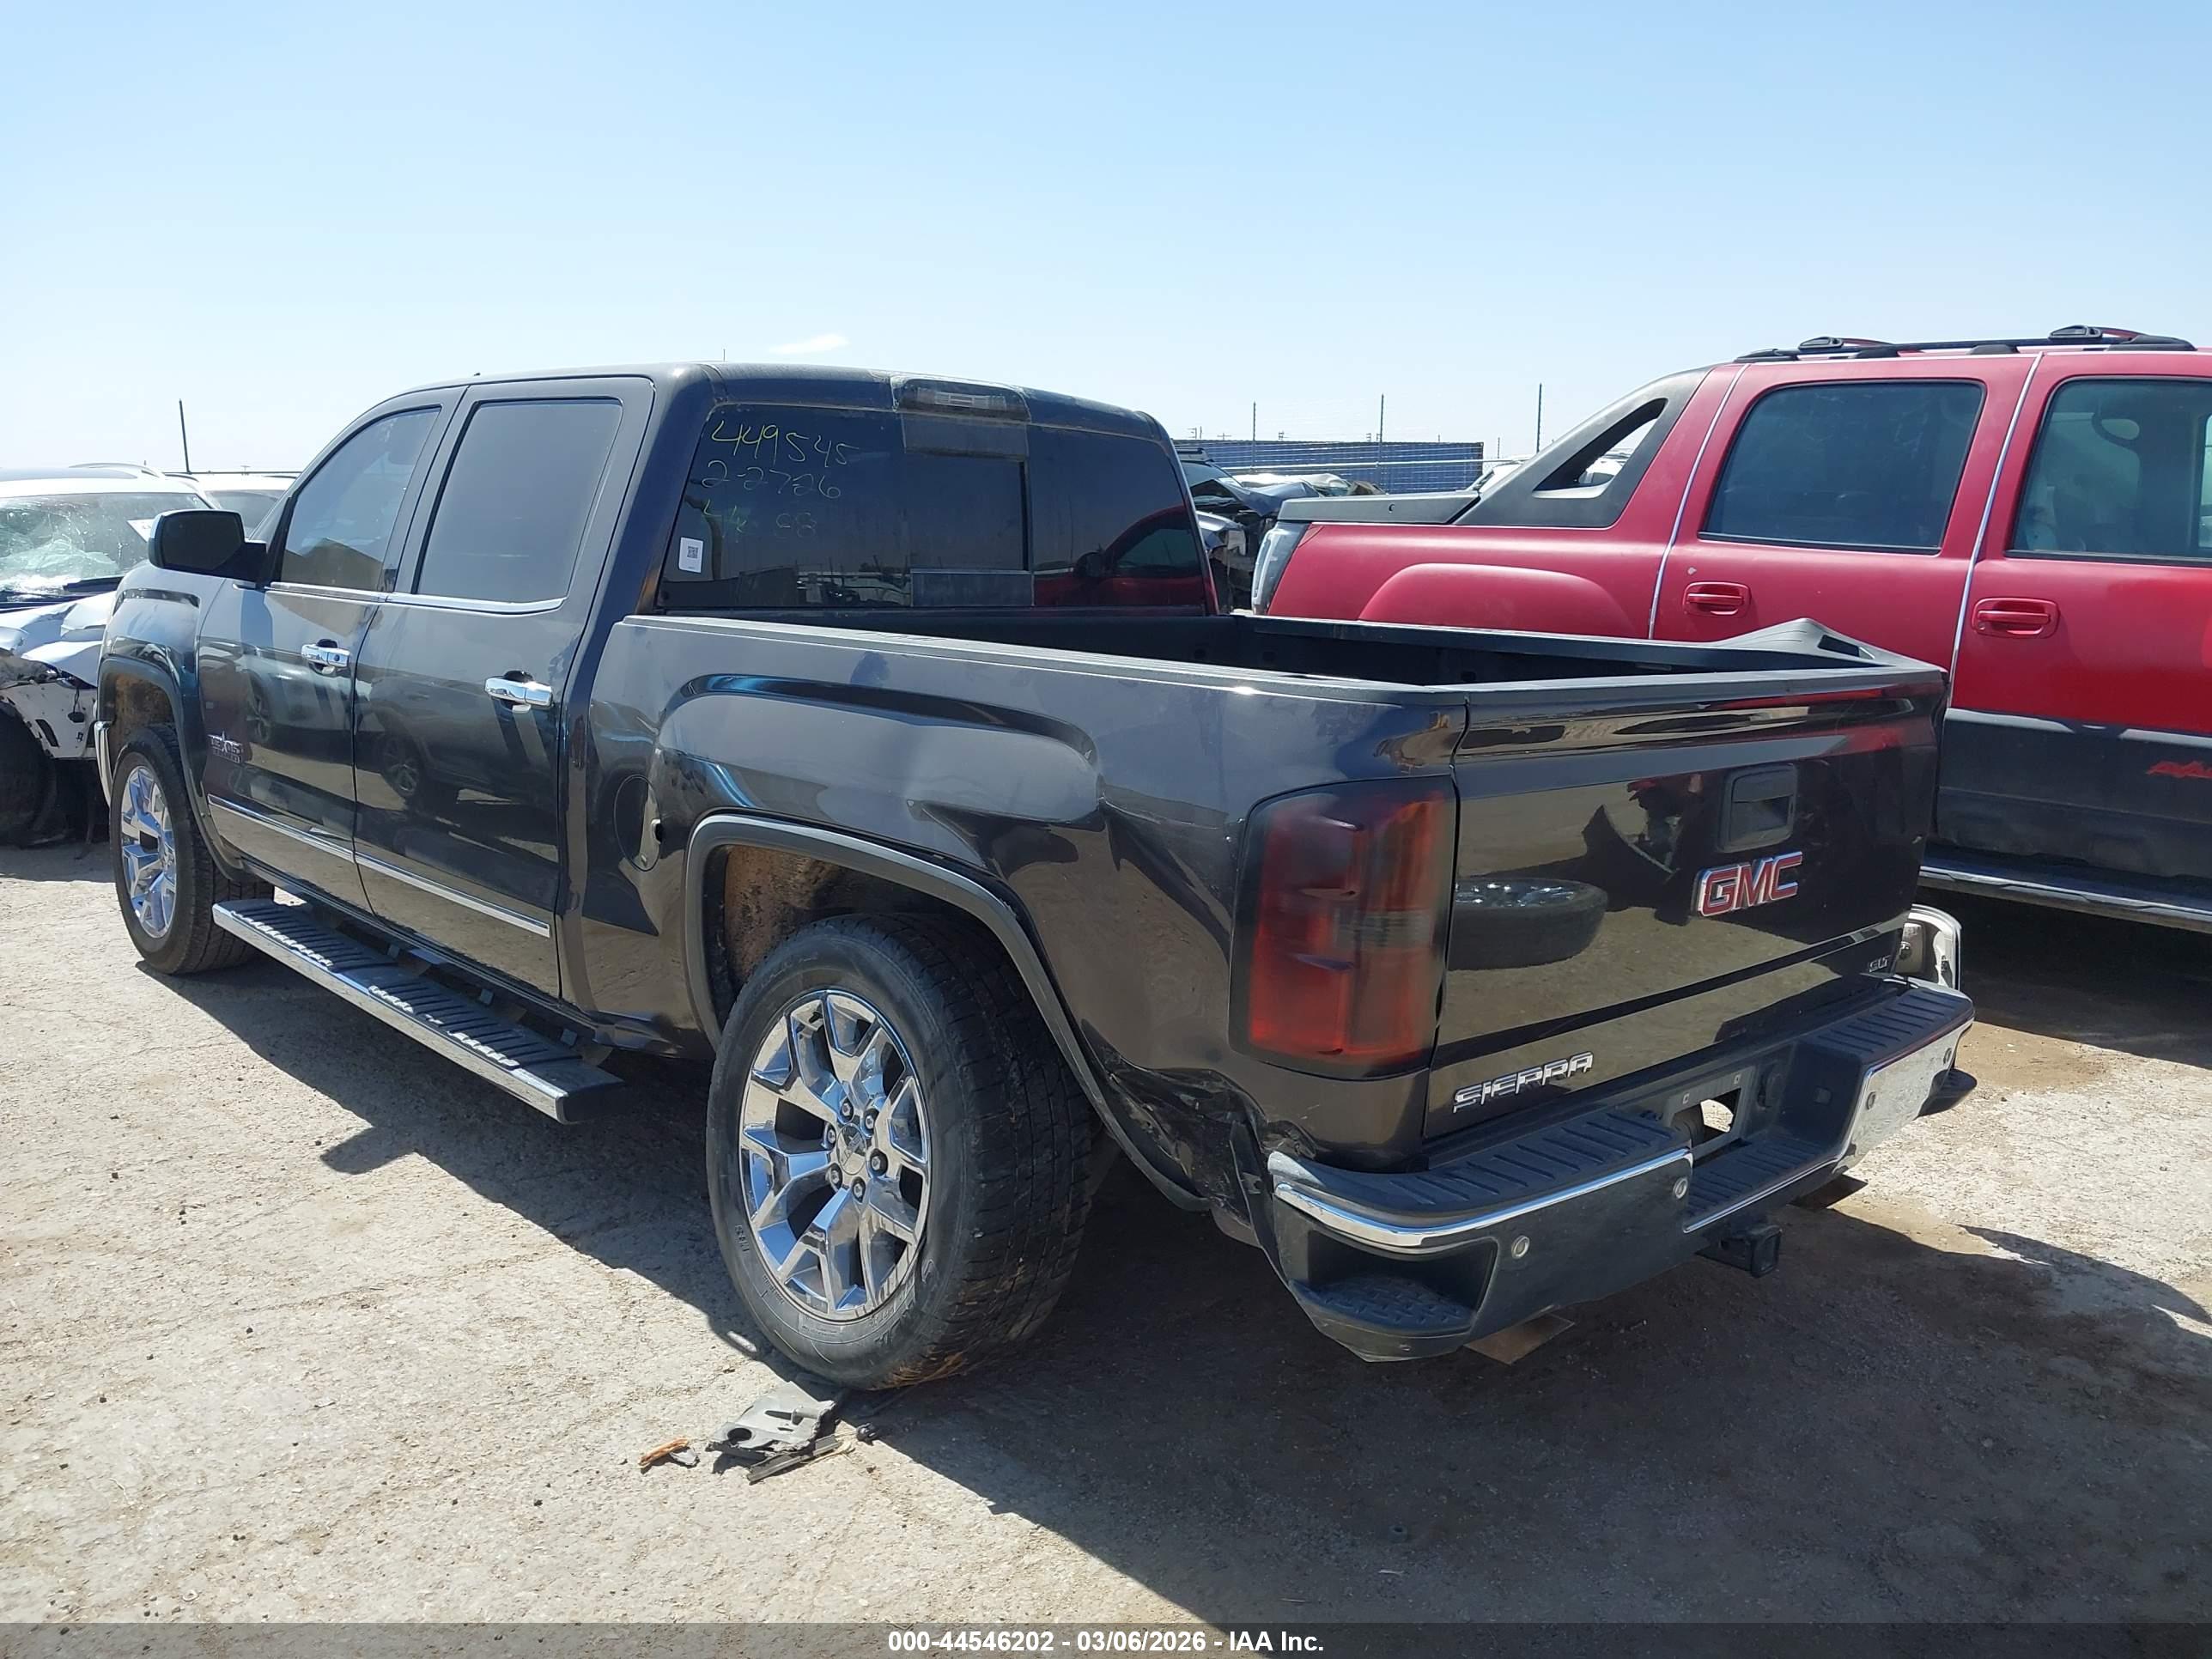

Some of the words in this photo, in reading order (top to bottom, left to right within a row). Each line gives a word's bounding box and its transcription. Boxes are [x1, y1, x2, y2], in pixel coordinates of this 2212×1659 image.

[711, 420, 860, 468] 449545
[1697, 851, 1803, 917] GMC
[1452, 1052, 1594, 1114] SIERRA
